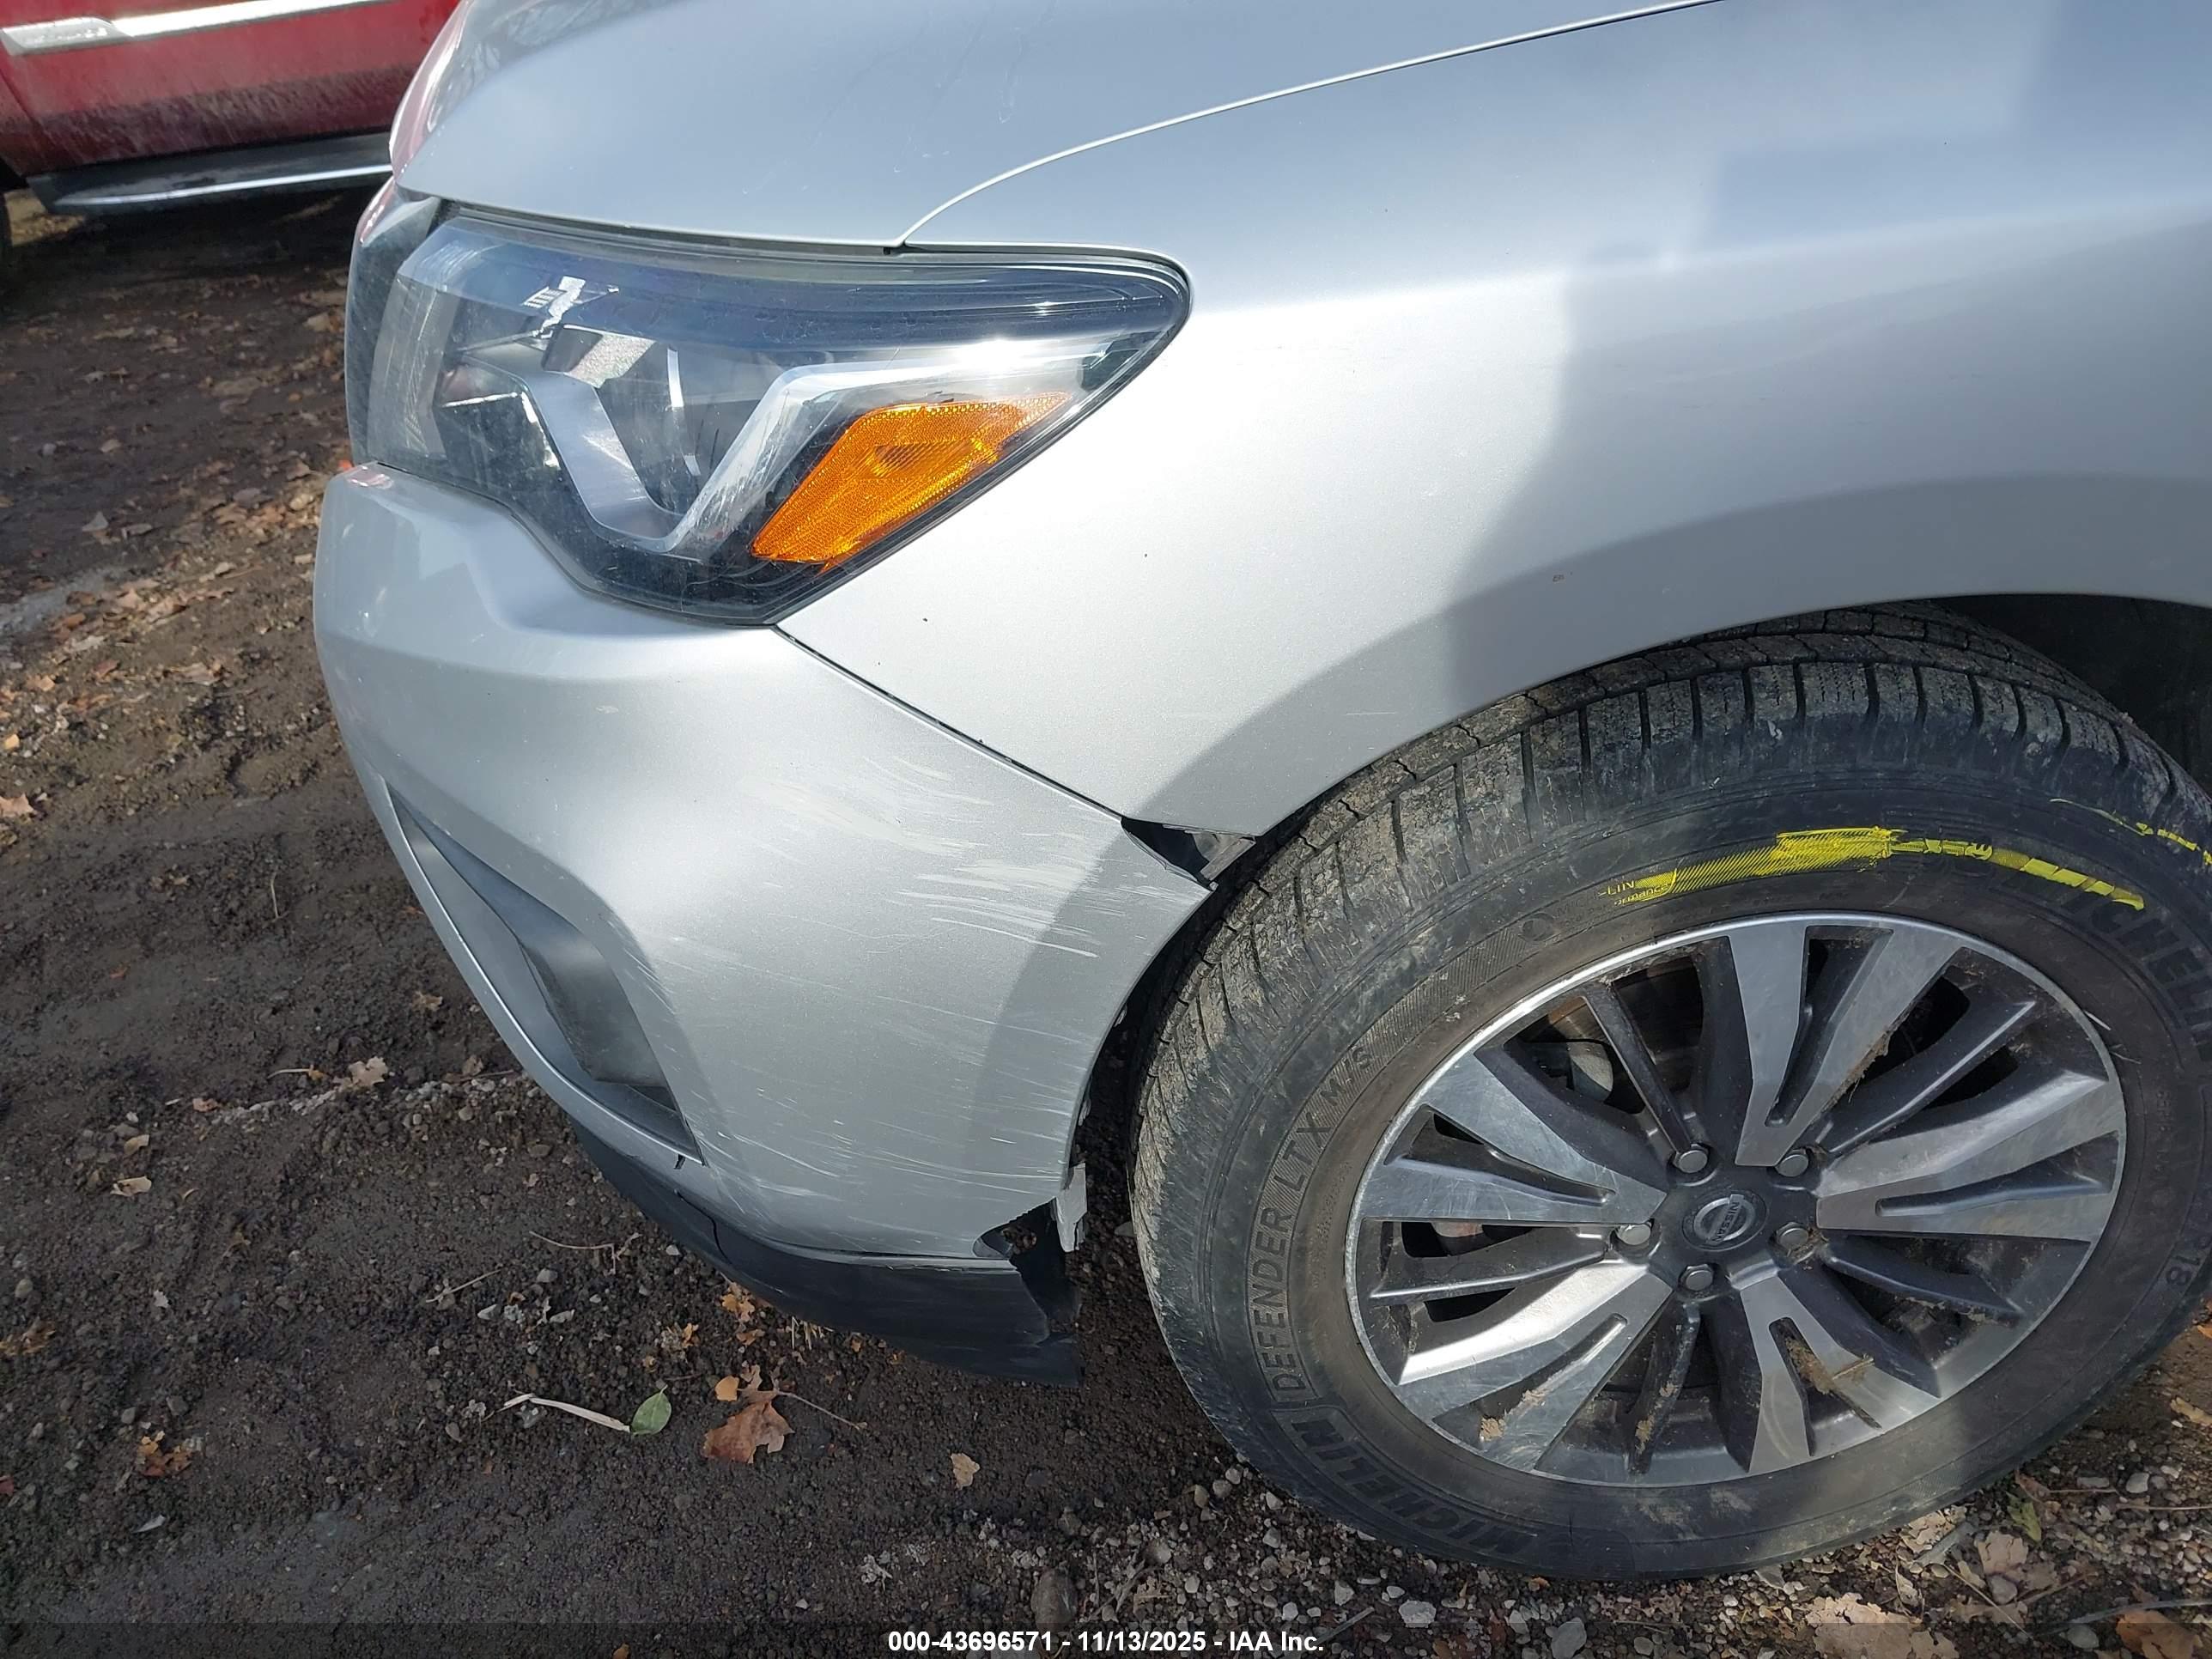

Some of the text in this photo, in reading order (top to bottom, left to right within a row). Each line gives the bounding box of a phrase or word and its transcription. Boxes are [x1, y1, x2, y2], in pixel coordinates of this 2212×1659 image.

[1999, 857, 2212, 1062] MICHEL
[1320, 1046, 1374, 1108] M/S
[1273, 1111, 1334, 1192] LTX
[1711, 1201, 1741, 1243] NISSAN
[1251, 1206, 1307, 1393] DEFENDER
[1291, 1419, 1534, 1555] MICHELIN
